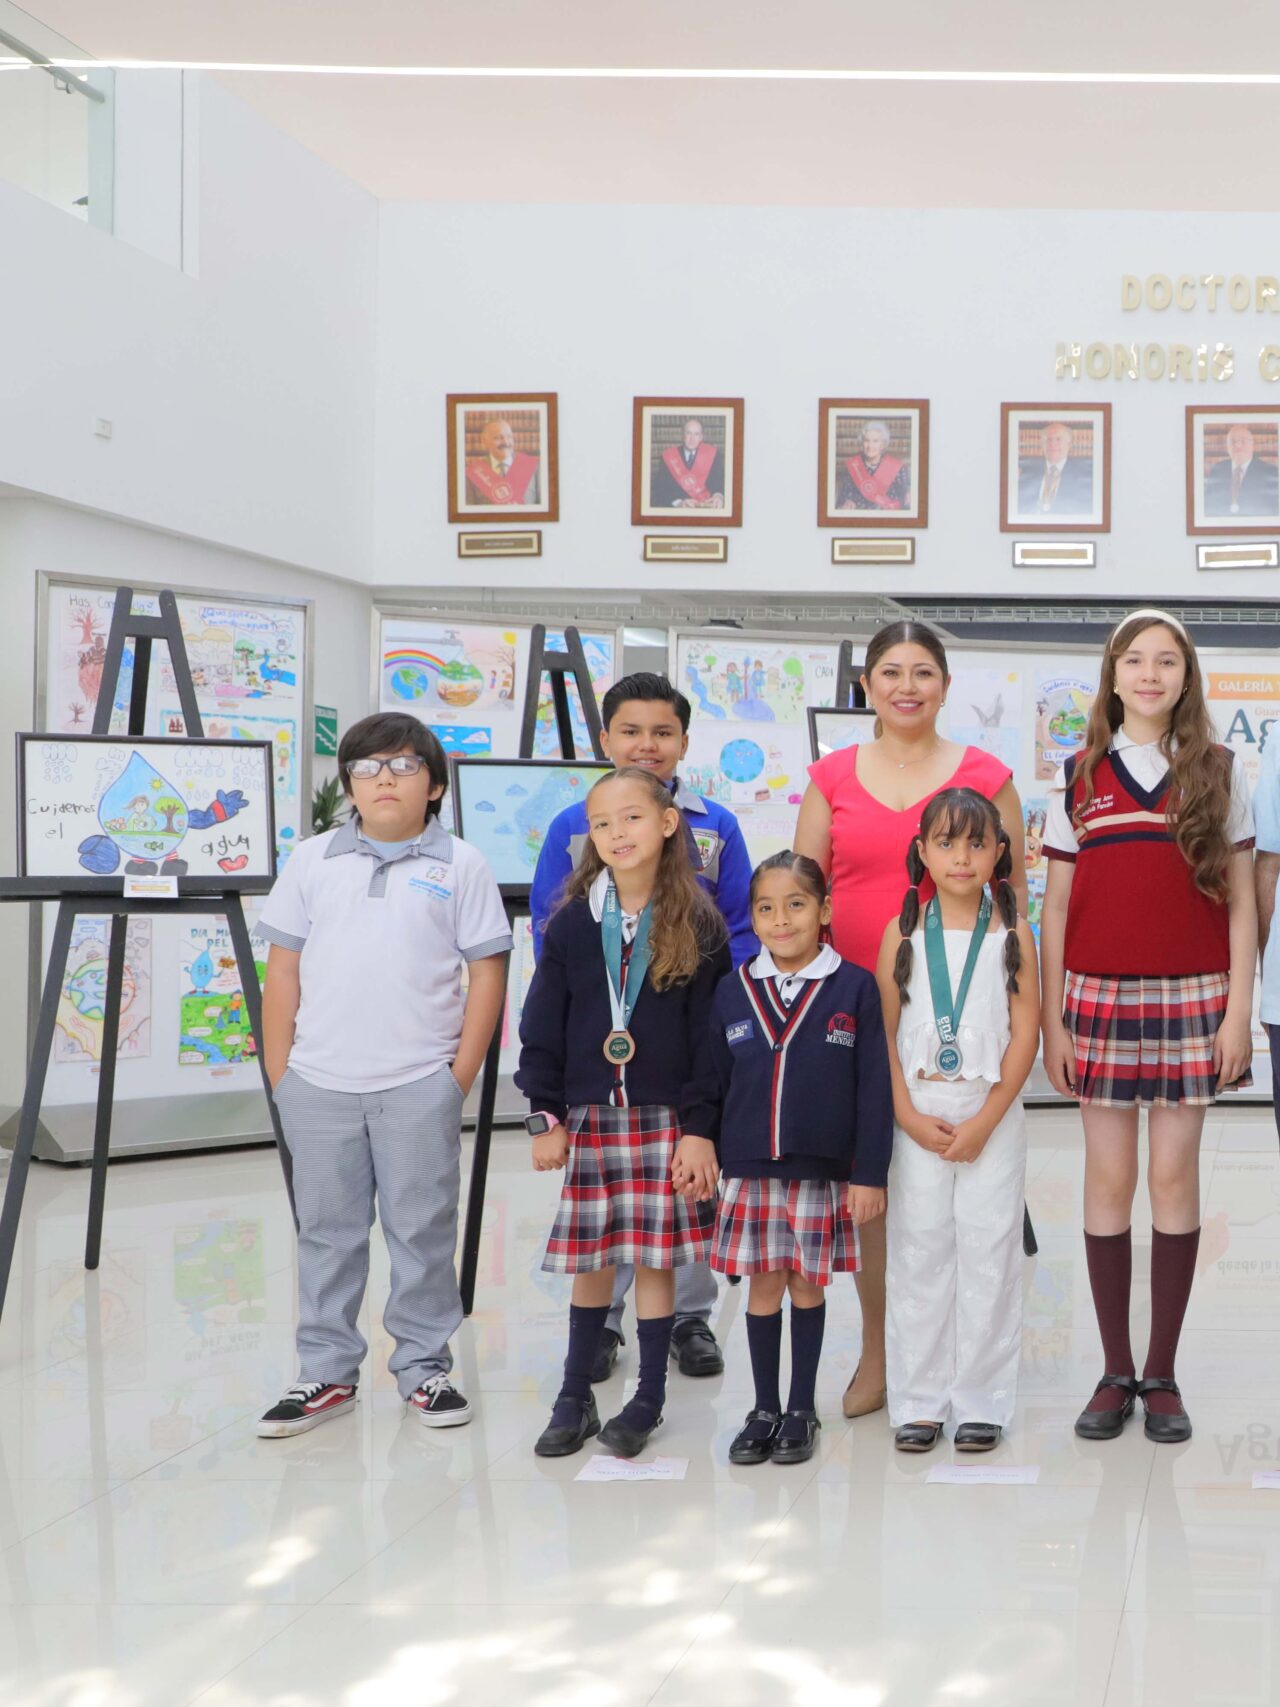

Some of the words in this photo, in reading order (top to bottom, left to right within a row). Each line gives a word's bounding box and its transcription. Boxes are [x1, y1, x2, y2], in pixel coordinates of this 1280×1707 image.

[1055, 342, 1235, 381] HONORIS
[1218, 678, 1273, 693] GALERÍA
[45, 821, 63, 839] el
[201, 834, 250, 856] agua
[825, 1034, 855, 1047] MENDEL
